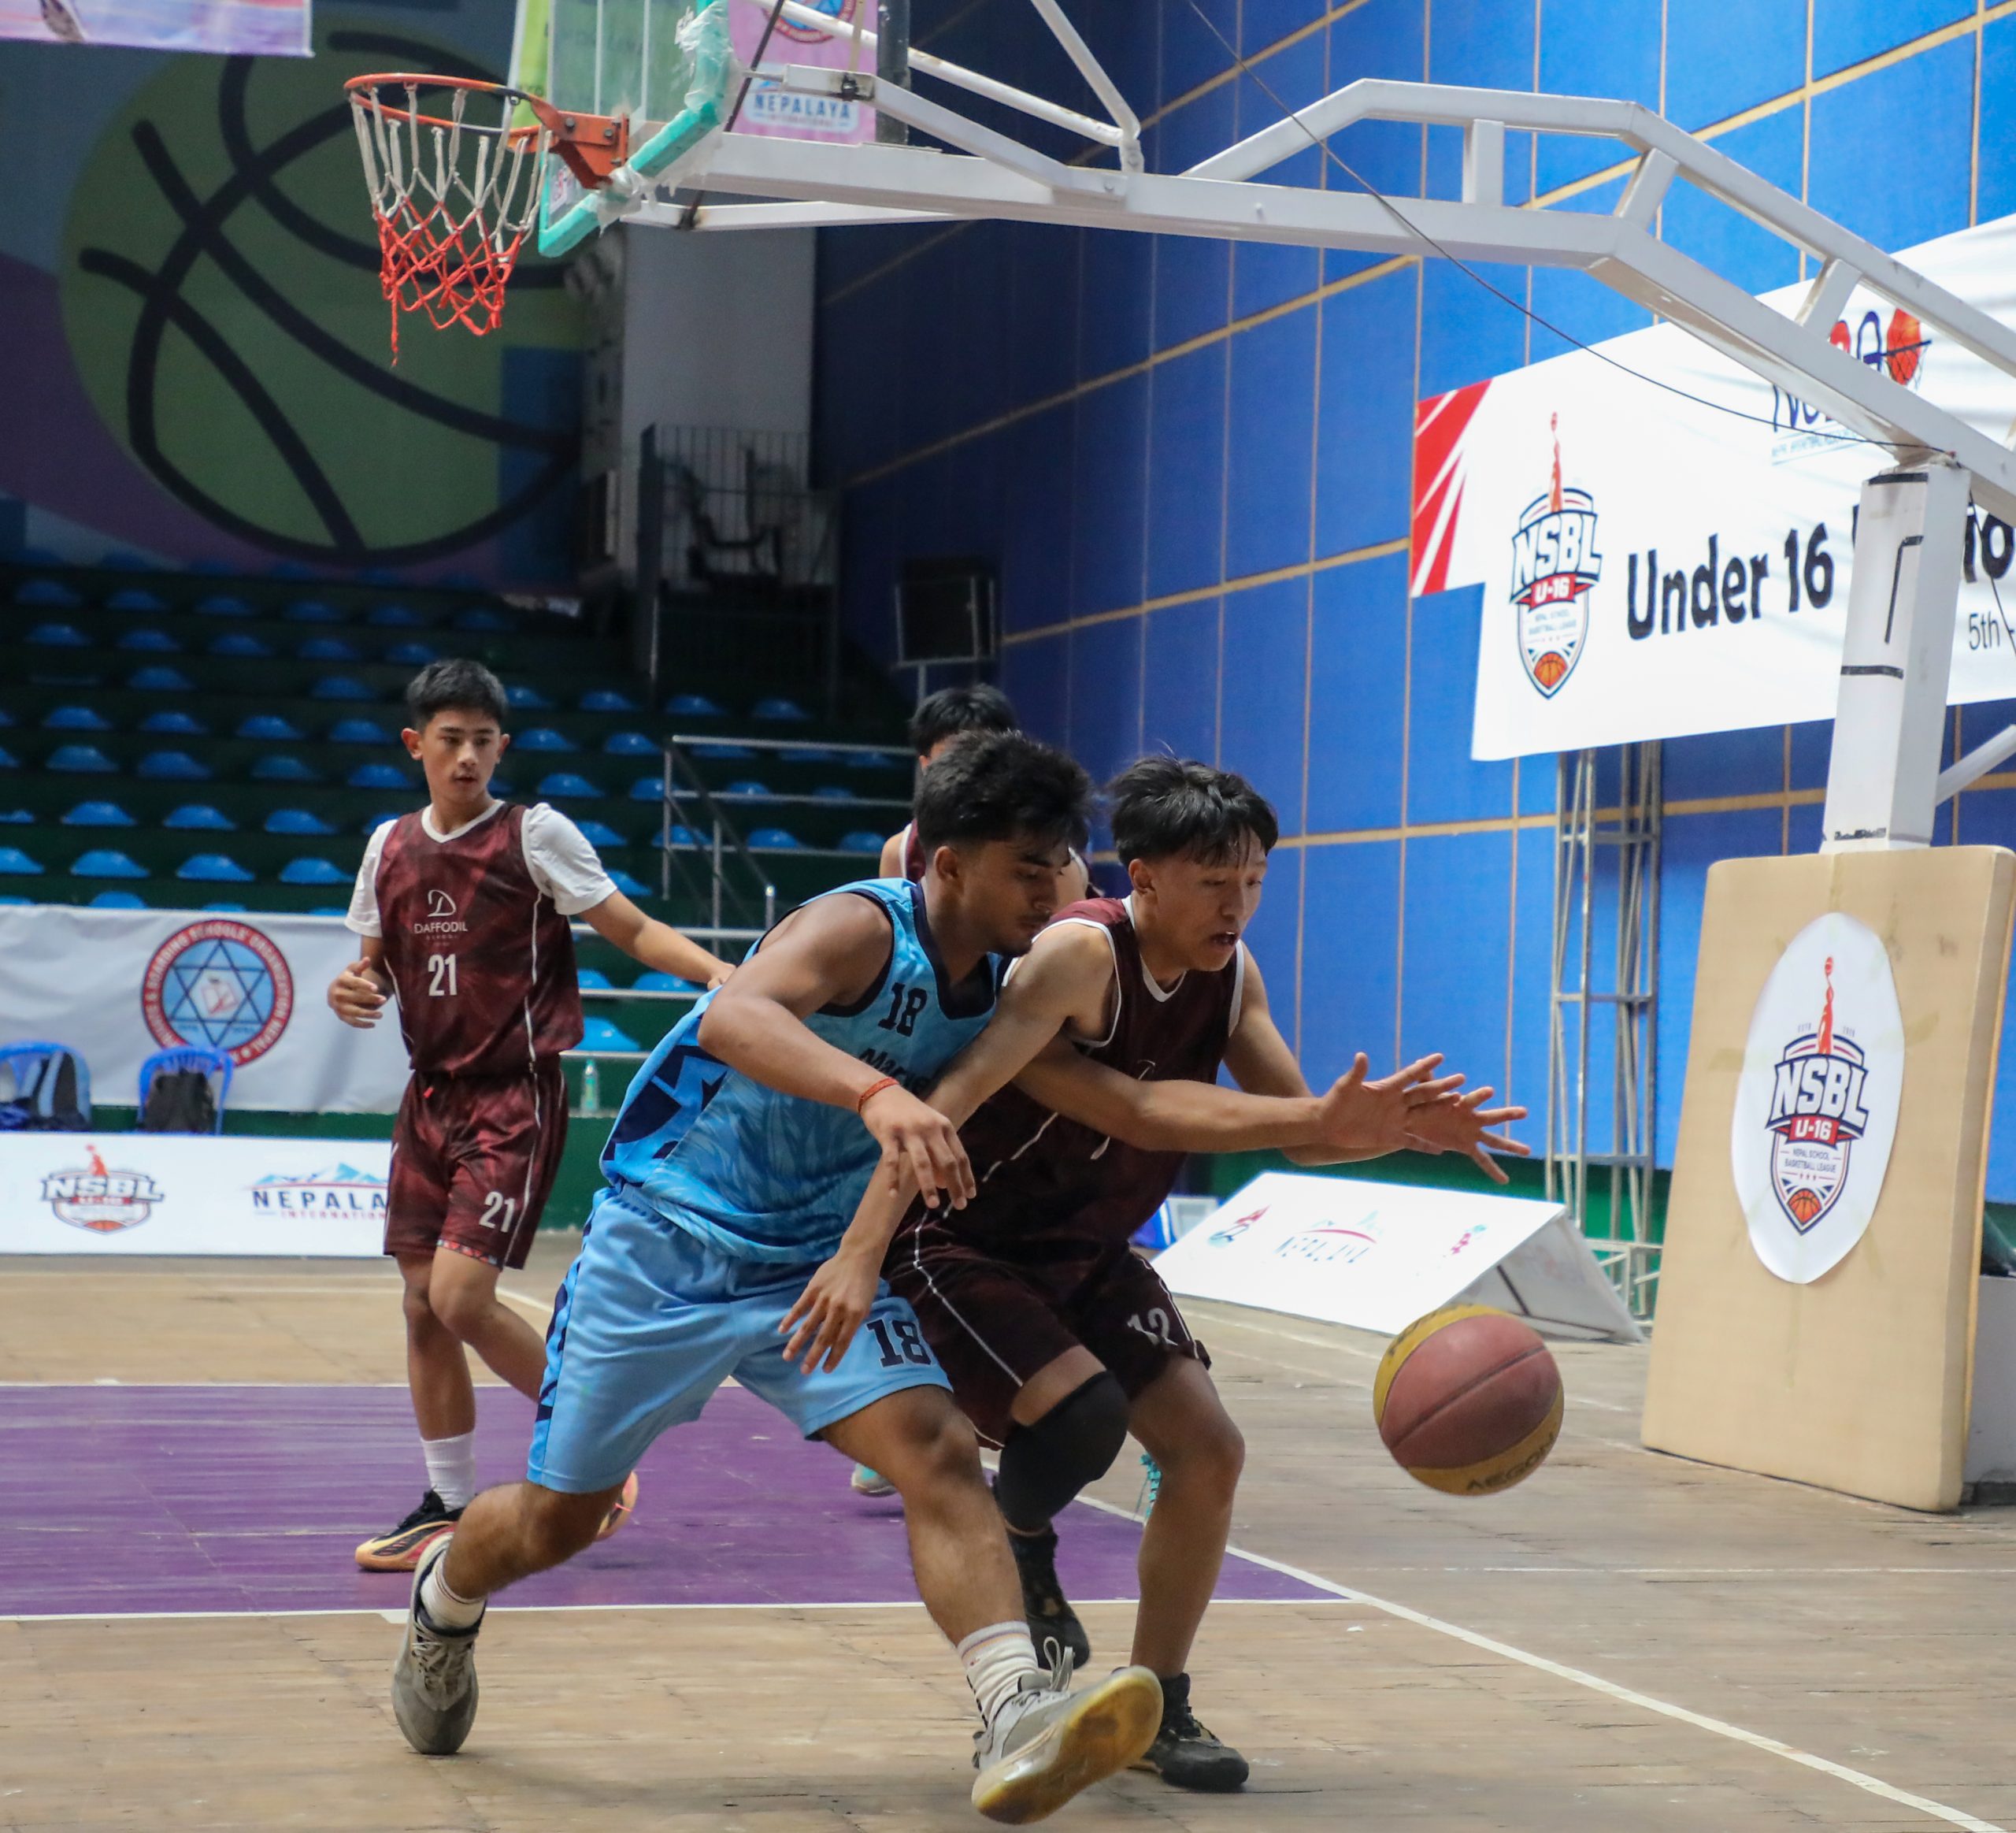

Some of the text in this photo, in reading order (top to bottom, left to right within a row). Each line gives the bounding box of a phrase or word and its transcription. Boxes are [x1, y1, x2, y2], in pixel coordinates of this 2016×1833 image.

[754, 93, 850, 118] NEPALAYA
[1510, 510, 1603, 601] NSBL
[1533, 576, 1570, 603] U-16
[1627, 532, 1769, 640] Under
[1784, 521, 1834, 613] 16
[1970, 611, 2000, 651] 5th
[413, 922, 469, 934] DAFFODIL
[428, 953, 458, 996] 21
[878, 982, 928, 1037] 18
[1766, 1056, 1870, 1134] NSBL
[1794, 1119, 1833, 1141] U-16
[40, 1177, 165, 1202] NSBL
[479, 1191, 517, 1233] 21
[867, 1319, 932, 1367] 18
[1127, 1307, 1178, 1347] 12
